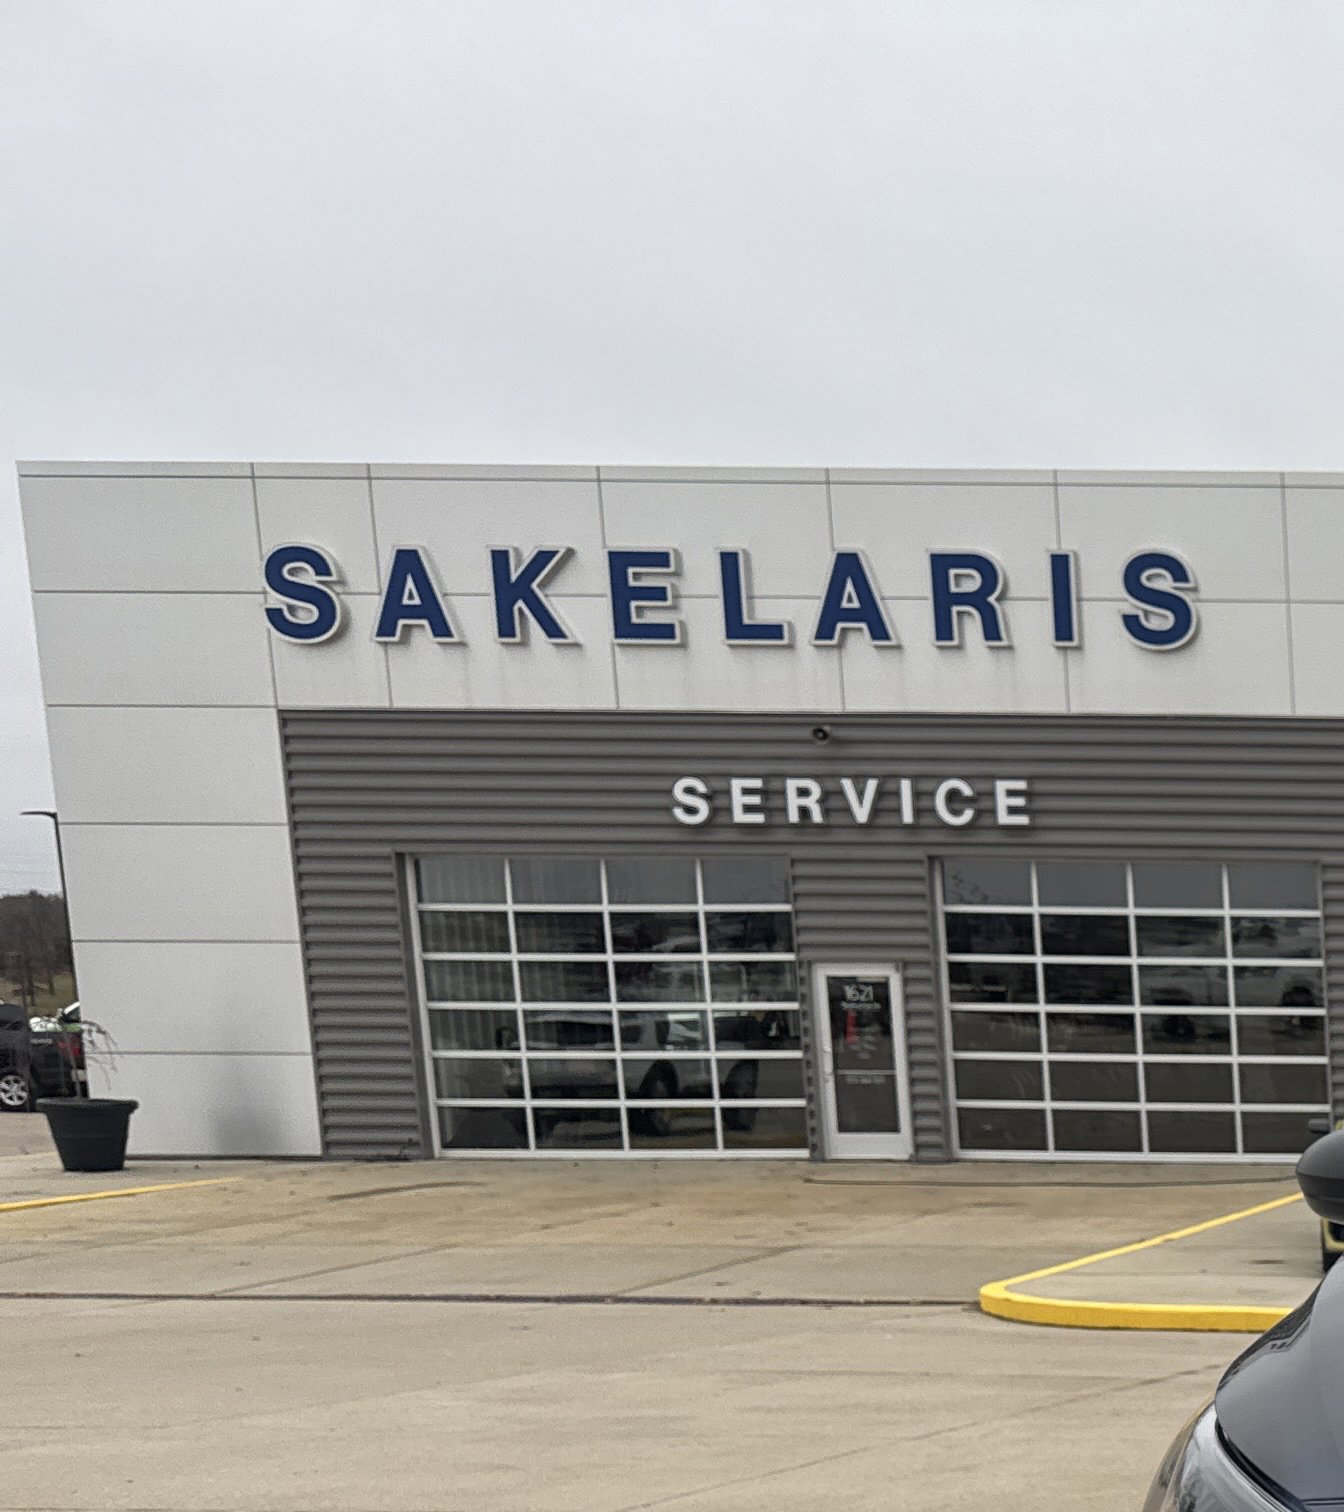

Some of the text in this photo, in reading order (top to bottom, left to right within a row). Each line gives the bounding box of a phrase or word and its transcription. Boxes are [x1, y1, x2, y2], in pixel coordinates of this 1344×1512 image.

[264, 543, 1199, 650] SAKELARIS
[673, 777, 1031, 826] SERVICE
[844, 984, 874, 1002] 1621
